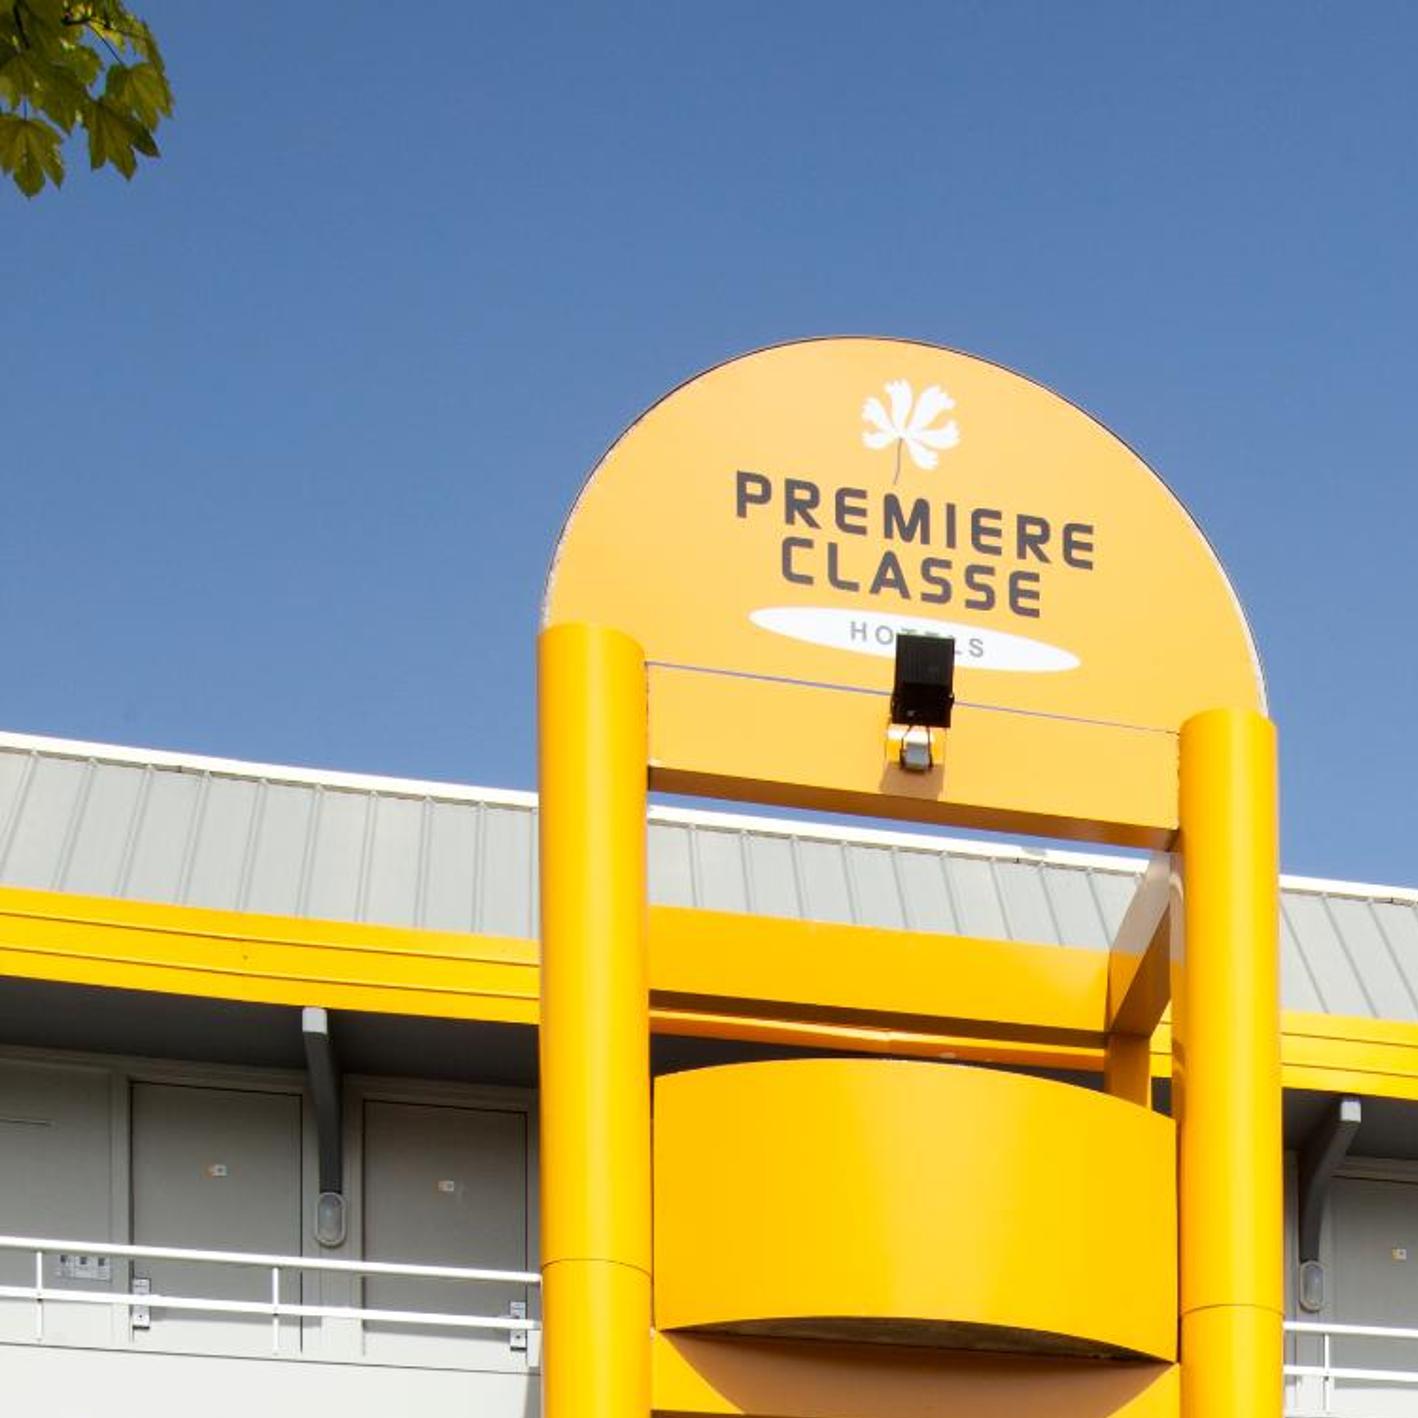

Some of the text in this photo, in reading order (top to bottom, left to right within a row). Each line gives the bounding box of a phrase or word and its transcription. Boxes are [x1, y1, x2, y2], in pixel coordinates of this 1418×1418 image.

[737, 471, 1092, 570] PREMIERE
[783, 537, 1039, 617] CLASSE
[849, 620, 985, 659] HOS
